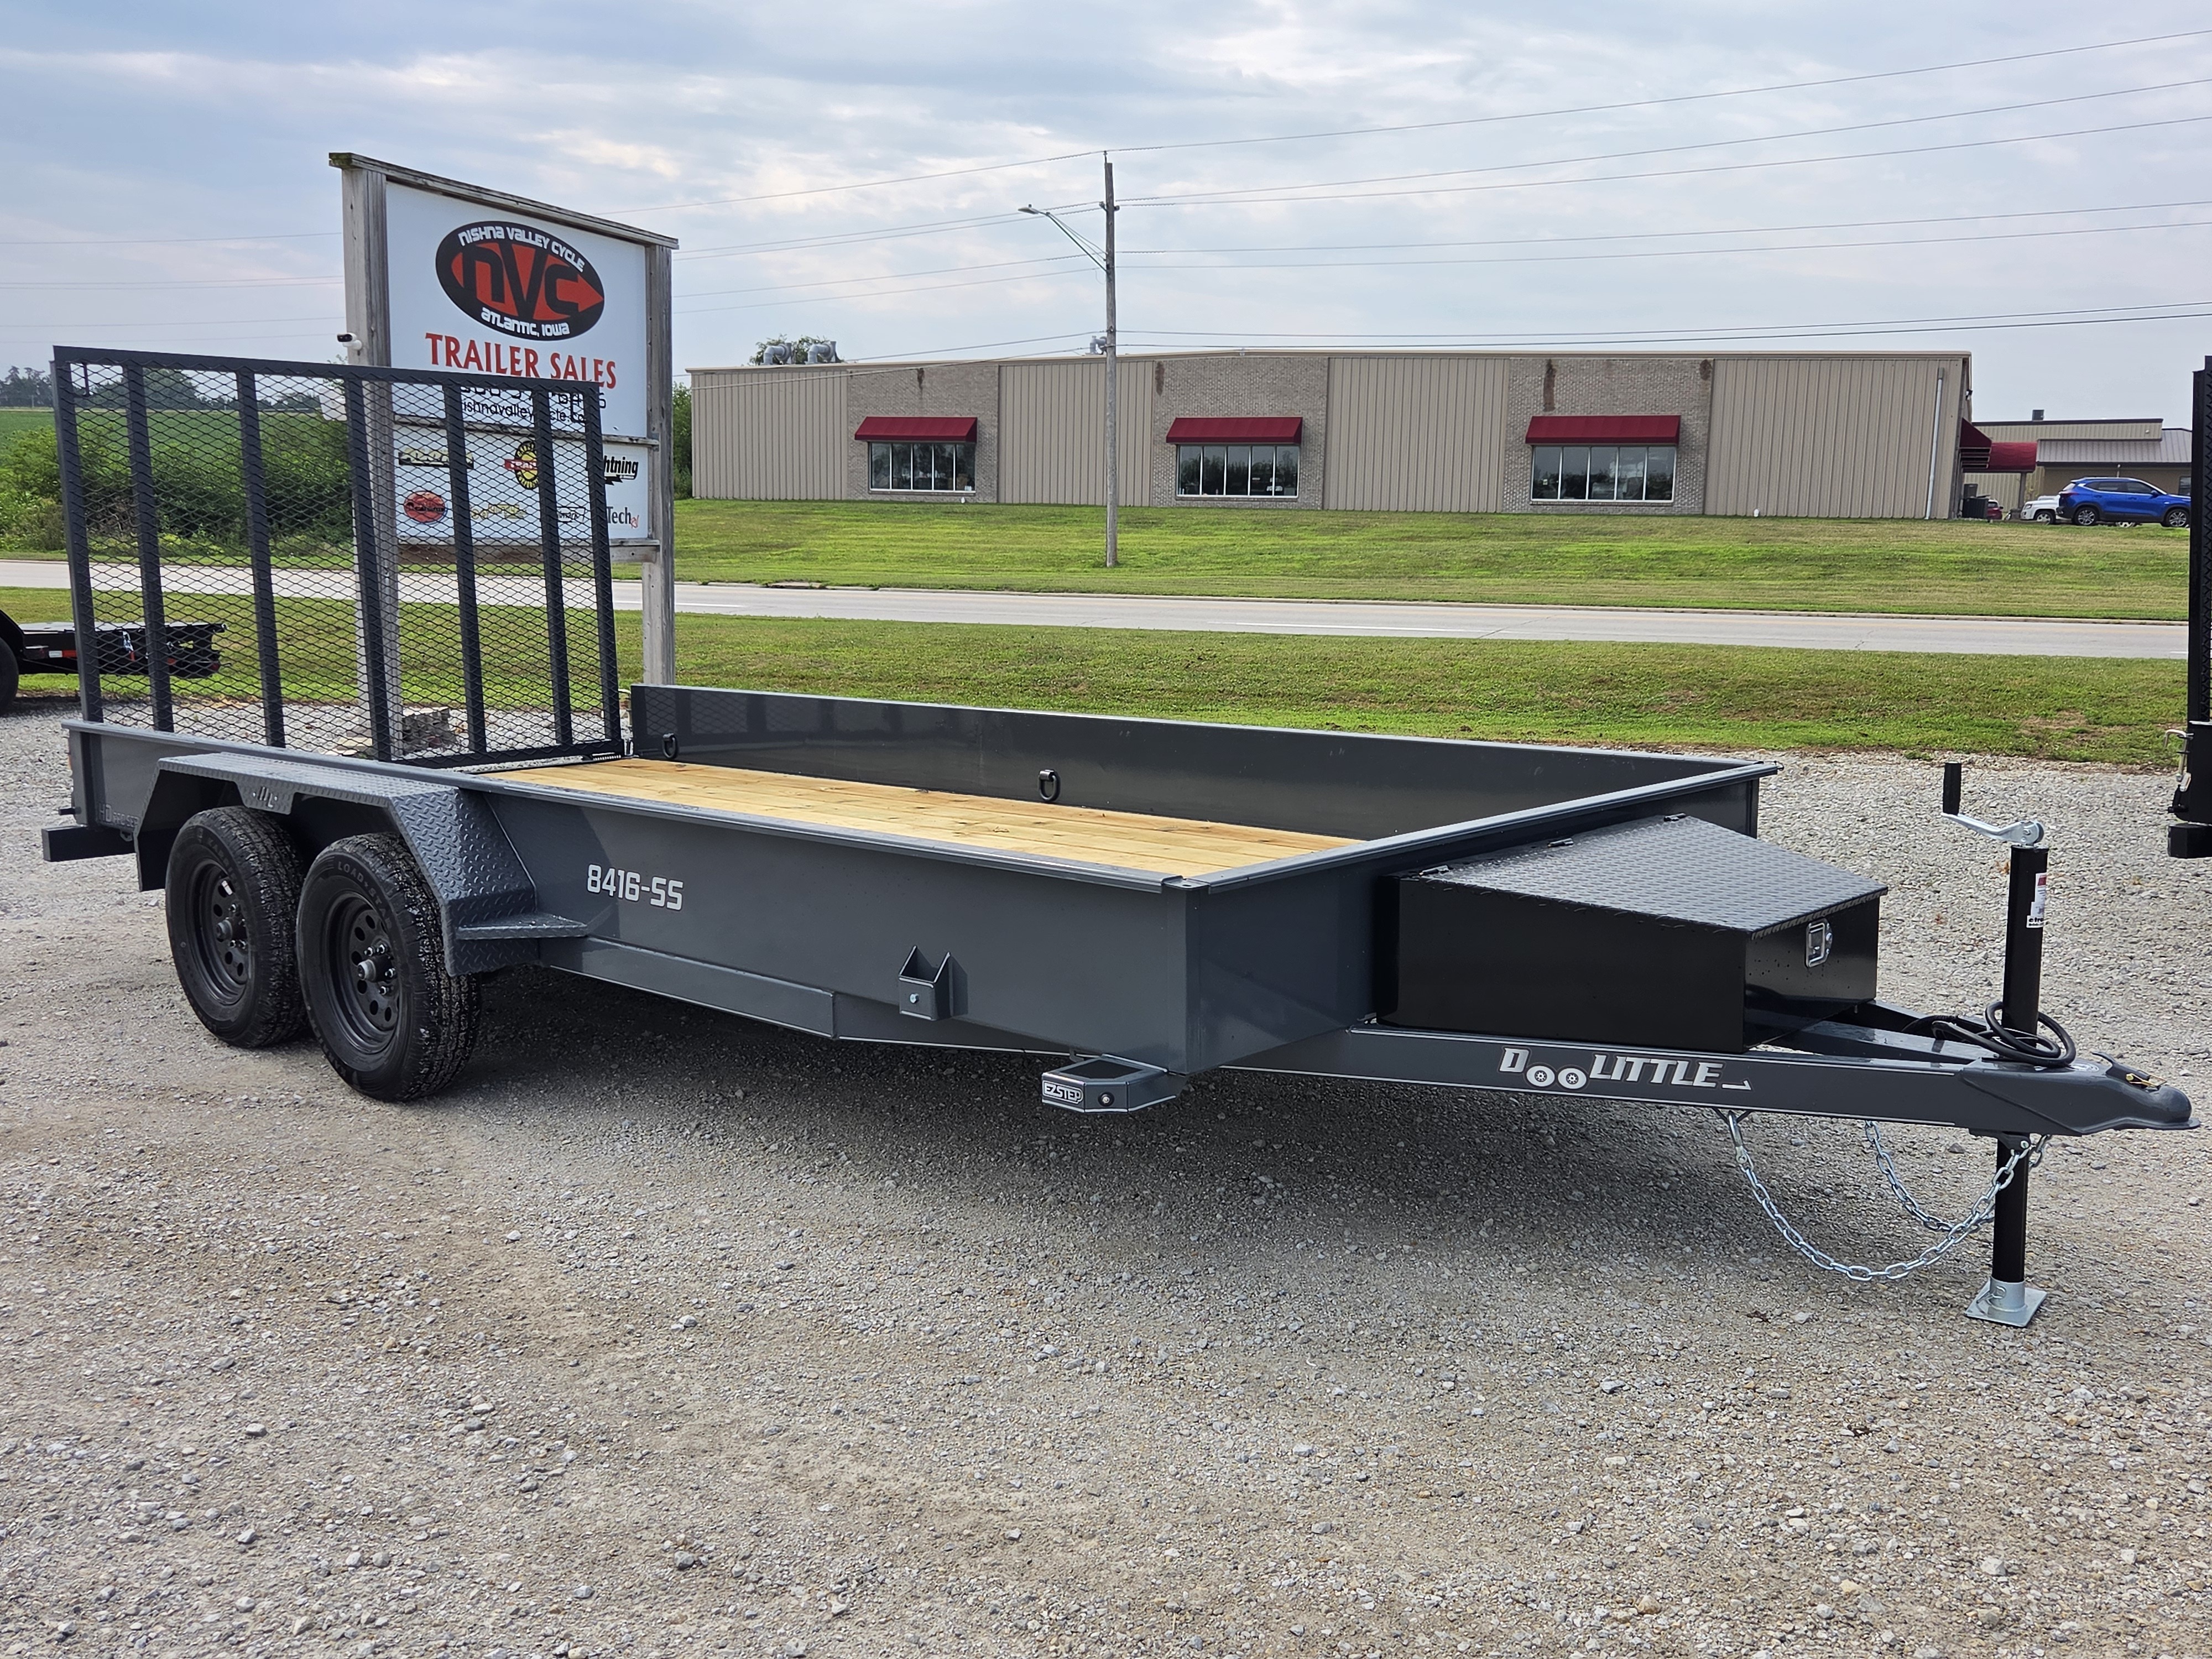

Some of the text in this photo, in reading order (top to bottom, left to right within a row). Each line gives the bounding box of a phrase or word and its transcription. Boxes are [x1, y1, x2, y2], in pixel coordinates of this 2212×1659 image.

[506, 227, 550, 249] VALLEY
[551, 241, 585, 273] CYCLE
[541, 322, 570, 336] IOWA
[425, 333, 617, 389] TRAILER SALES
